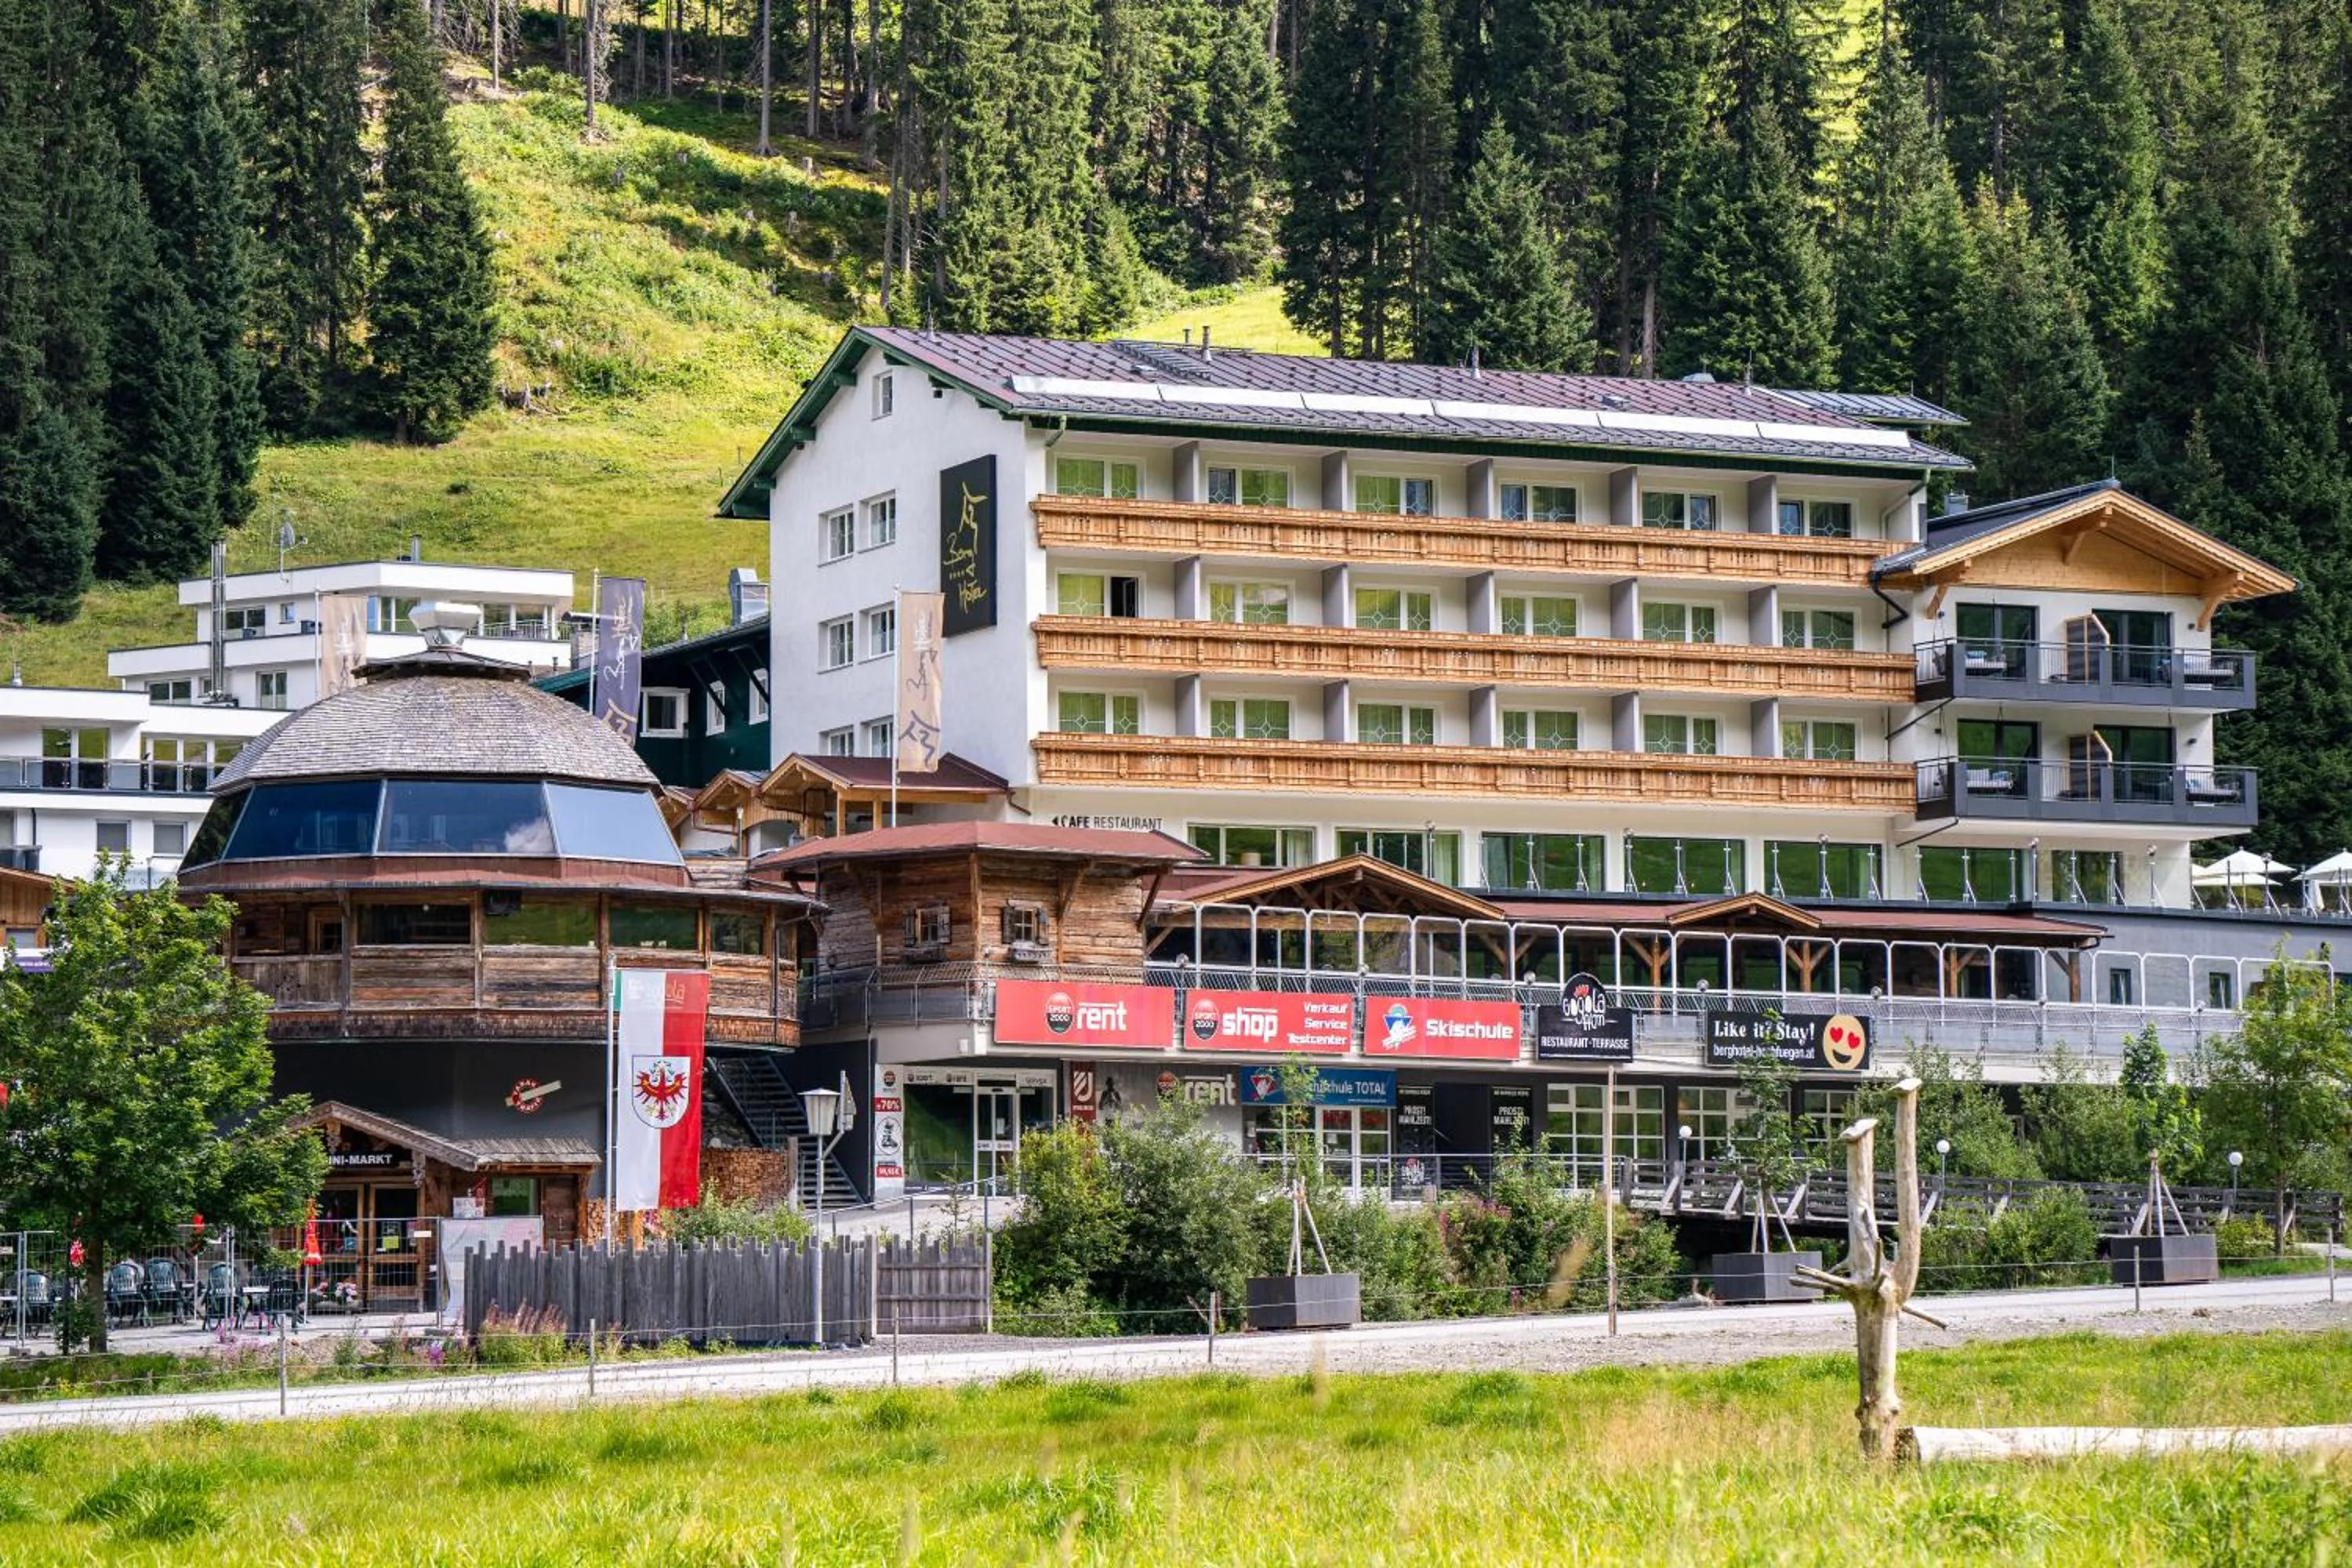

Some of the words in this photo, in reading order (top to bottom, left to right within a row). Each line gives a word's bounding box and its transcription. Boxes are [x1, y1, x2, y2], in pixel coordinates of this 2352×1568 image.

[1062, 815, 1089, 828] CAFE
[1094, 816, 1162, 830] RESTAURANT
[1304, 1001, 1348, 1014] Verkauf
[1076, 1000, 1127, 1031] rent
[1222, 1007, 1278, 1043] shop
[1305, 1018, 1348, 1029] Service
[1425, 1019, 1514, 1039] Skischule
[1287, 1033, 1347, 1045] Testcenter
[1714, 1020, 1747, 1037] Like
[1753, 1020, 1772, 1039] it?
[1774, 1022, 1815, 1046] Stay!
[1185, 1074, 1236, 1105] rent
[1355, 1081, 1387, 1095] TOTAL
[327, 1154, 392, 1164] INI-MARKT
